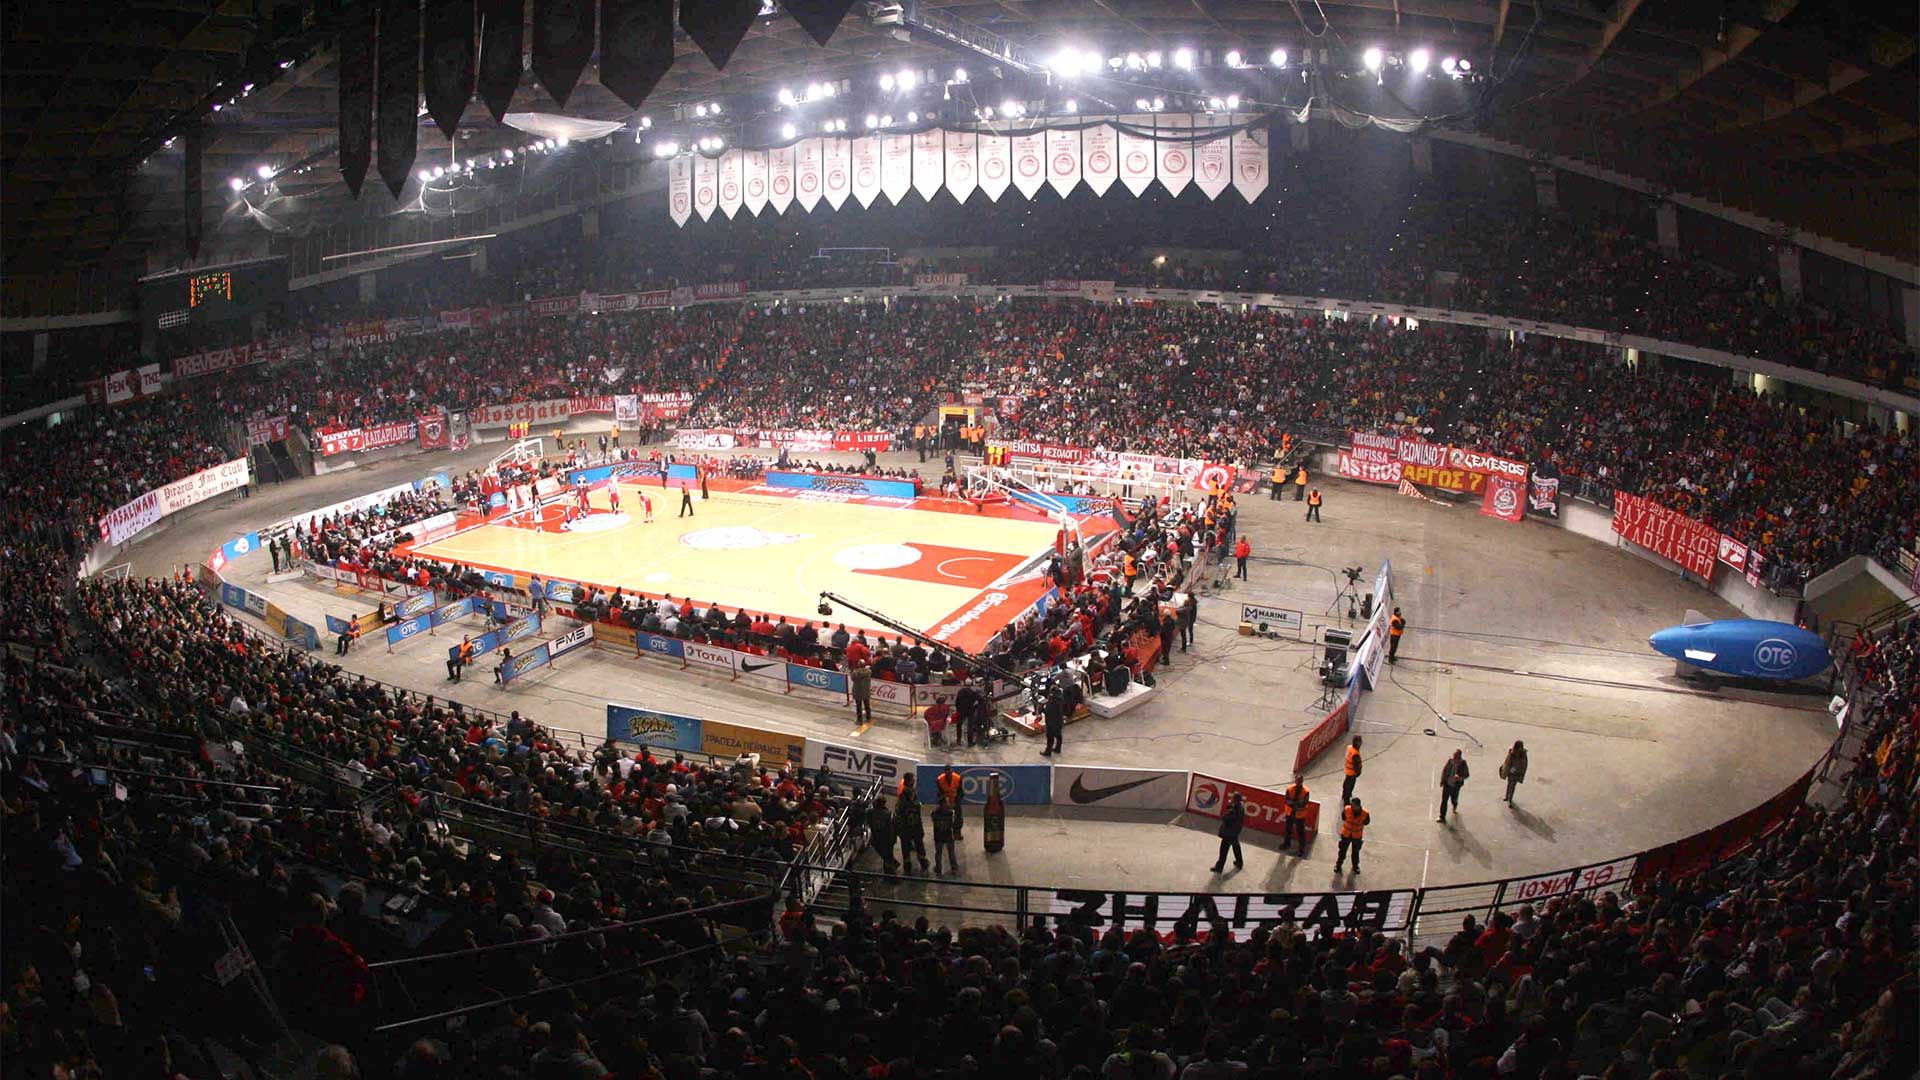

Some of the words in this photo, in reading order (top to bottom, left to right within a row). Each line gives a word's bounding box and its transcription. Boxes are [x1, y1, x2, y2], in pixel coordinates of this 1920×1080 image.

[470, 401, 569, 424] Moschato
[1351, 447, 1388, 464] AMFISSA
[1397, 440, 1438, 466] ΛΕΩΝΙΔΙΟ
[1440, 447, 1448, 467] 7
[1464, 453, 1526, 476] LEMESOS
[198, 472, 217, 490] Fan
[220, 462, 243, 478] Club
[1340, 454, 1402, 482] ASTROS
[1403, 464, 1465, 489] ΑΡΓΟΣ
[1469, 472, 1483, 491] 7
[1614, 498, 1718, 561] ΟΛΥΜΠΙΑΚΟΣ
[1610, 514, 1714, 581] ΞΥΛΟΚΑΣΤΡΟ
[1258, 609, 1288, 620] MARINE
[400, 622, 418, 636] OTE
[555, 628, 586, 649] FMS
[650, 638, 668, 650] OTE
[1757, 646, 1793, 665] OTE
[696, 648, 731, 665] TOTAL
[805, 669, 828, 686] OTE
[823, 746, 898, 778] FMS
